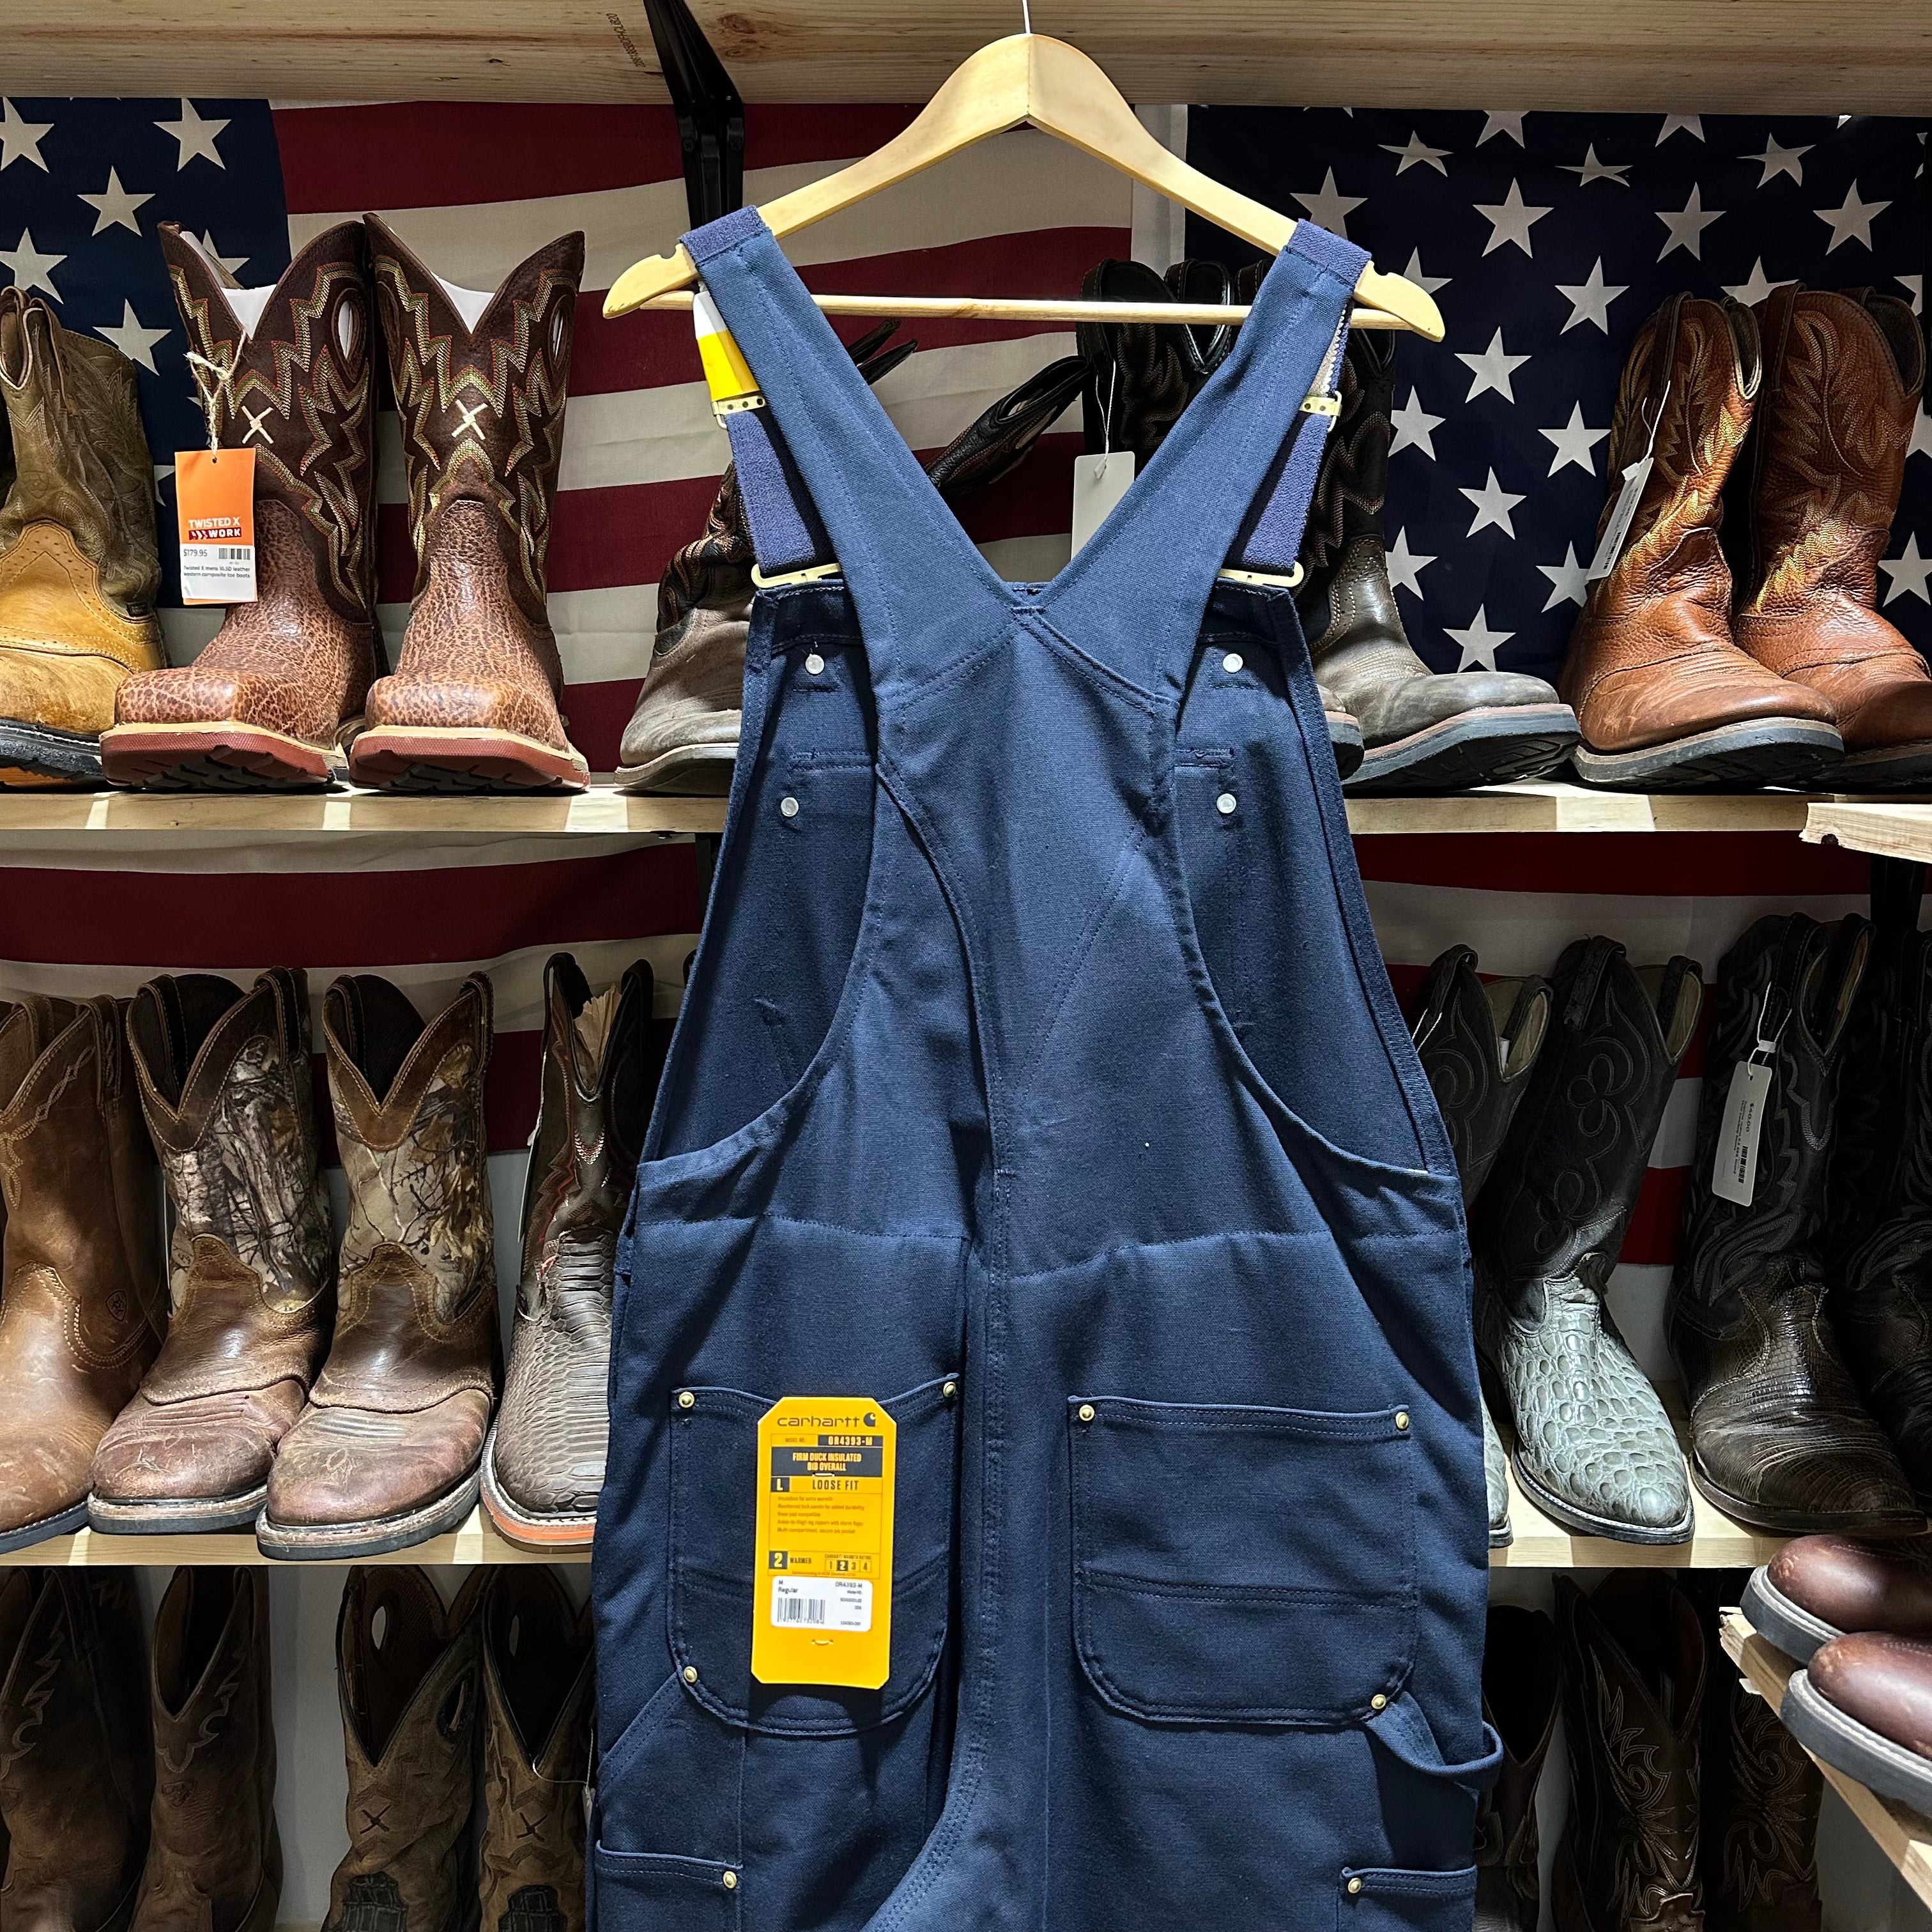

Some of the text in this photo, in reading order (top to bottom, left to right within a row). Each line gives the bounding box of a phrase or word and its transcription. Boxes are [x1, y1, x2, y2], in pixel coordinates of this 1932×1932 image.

[188, 516, 240, 528] TWISTED X
[208, 528, 241, 538] WORK
[183, 548, 208, 556] $179.95
[778, 1416, 860, 1427] carhartt
[793, 1452, 862, 1462] FIRM DUCK INSULATED
[807, 1462, 847, 1471] BIB OVERALL
[776, 1478, 783, 1491] L
[813, 1480, 859, 1491] LOOSE FIT
[774, 1552, 783, 1568] 2
[829, 1561, 868, 1571] 1 2 3 4
